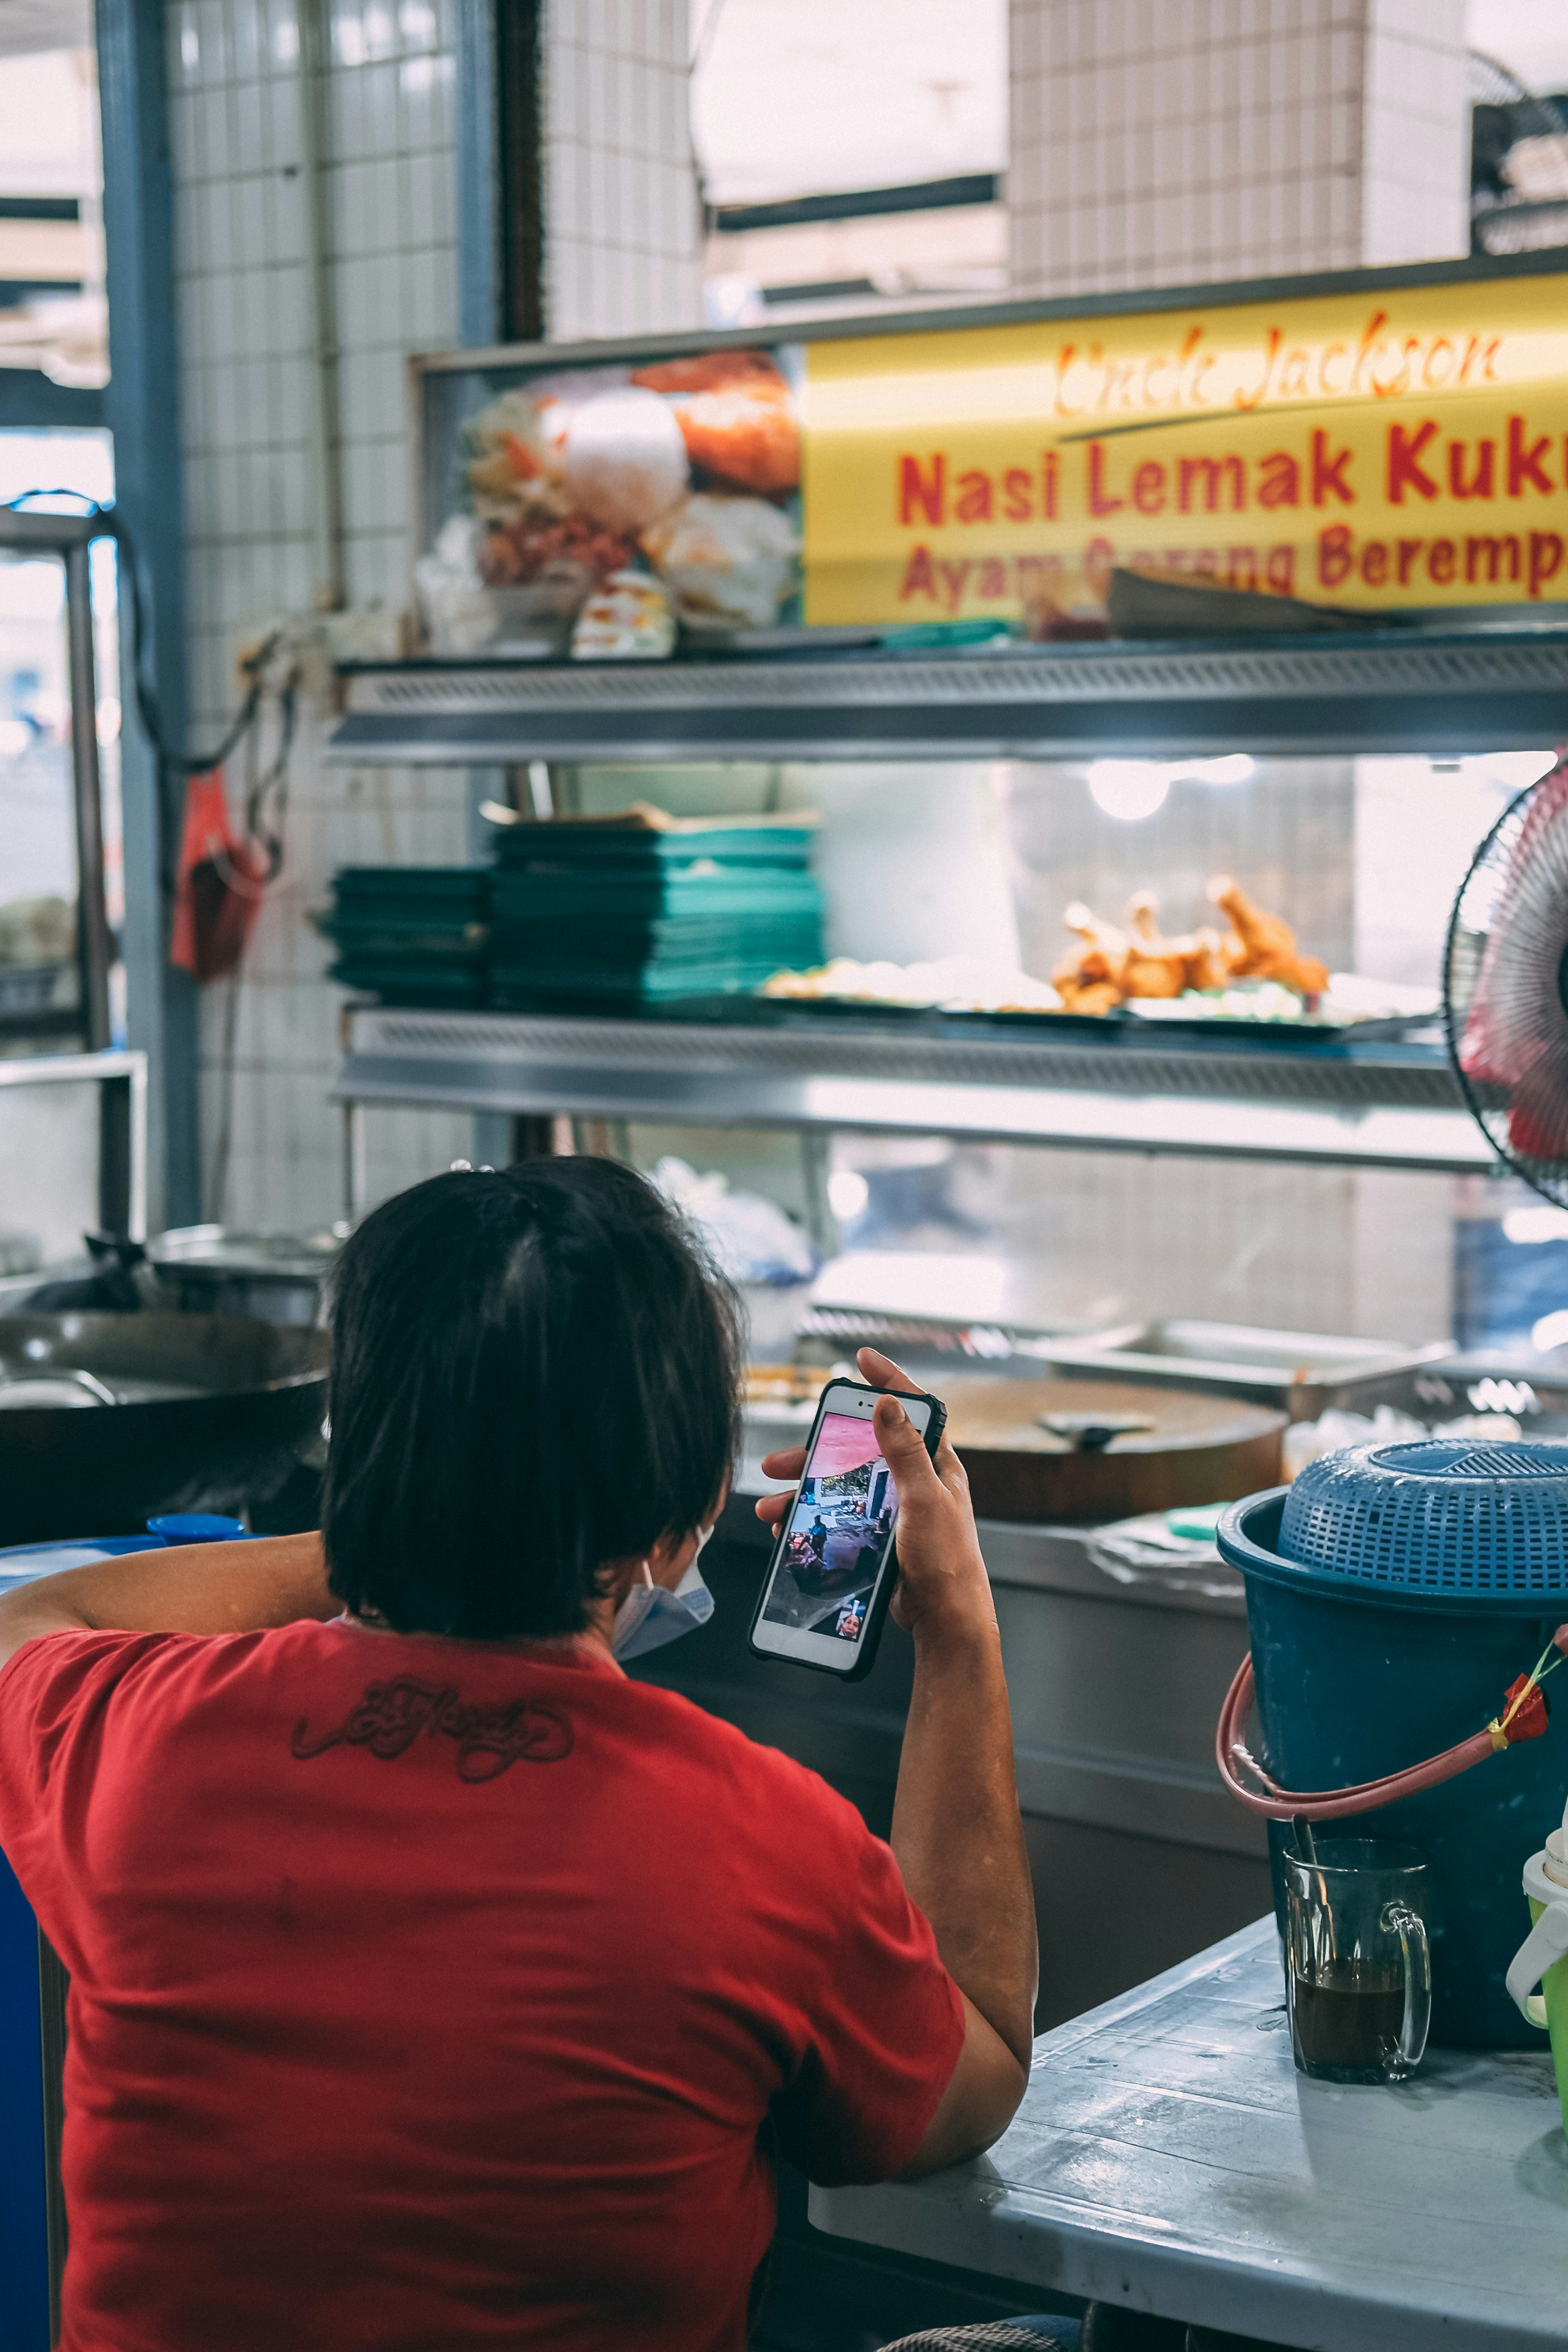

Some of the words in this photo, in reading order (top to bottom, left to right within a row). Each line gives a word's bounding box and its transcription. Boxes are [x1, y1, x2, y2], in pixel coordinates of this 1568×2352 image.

[1234, 310, 1505, 412] Jackson
[898, 451, 1062, 527] Nasi
[1087, 428, 1358, 517] Lemak
[1386, 415, 1568, 505] Kuk
